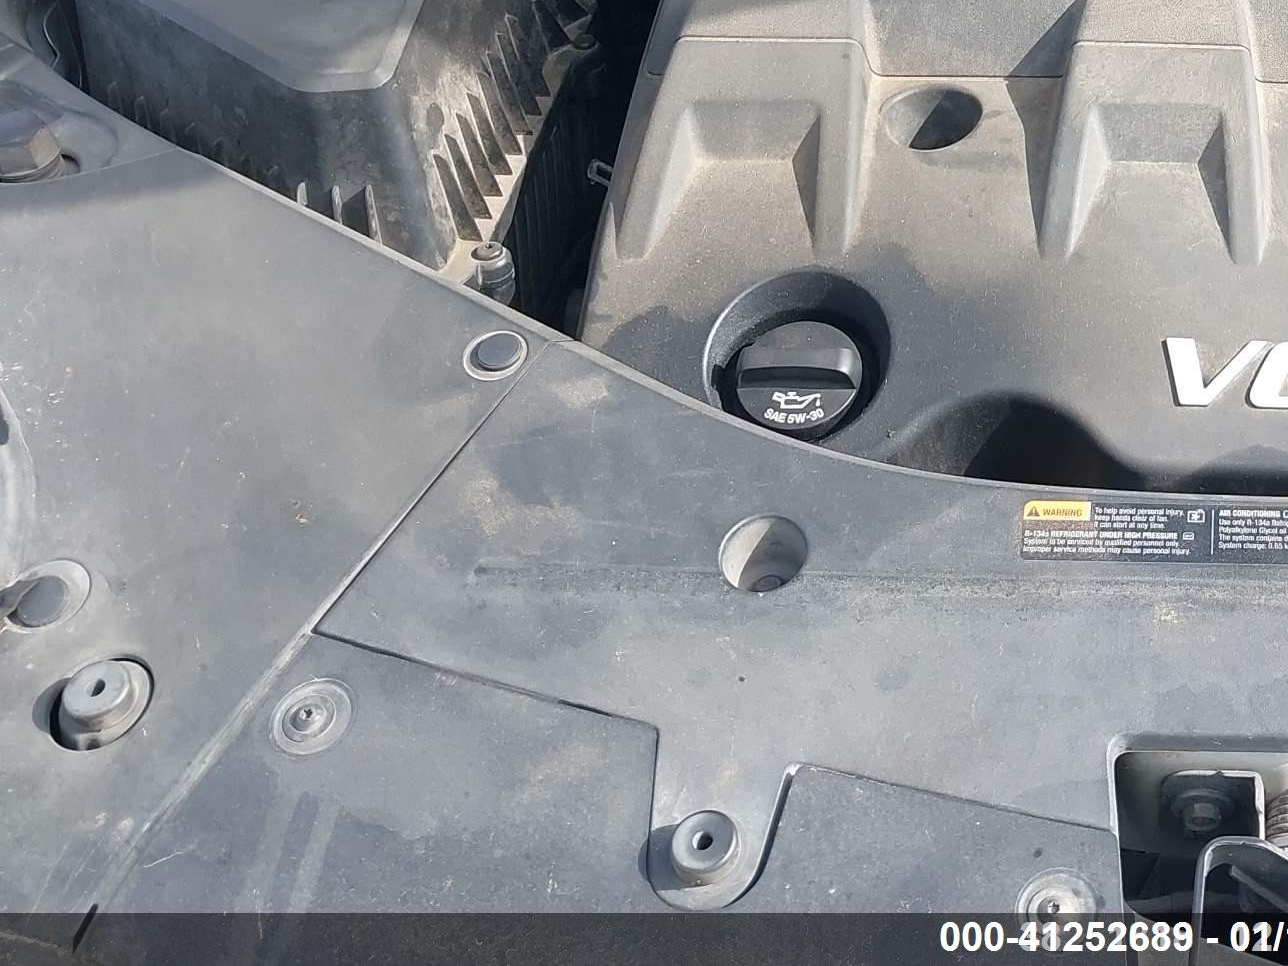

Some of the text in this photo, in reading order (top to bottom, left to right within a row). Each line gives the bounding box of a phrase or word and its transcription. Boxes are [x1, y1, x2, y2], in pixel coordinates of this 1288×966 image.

[764, 408, 825, 424] SAE 5W-30
[1042, 508, 1083, 517] WARNING
